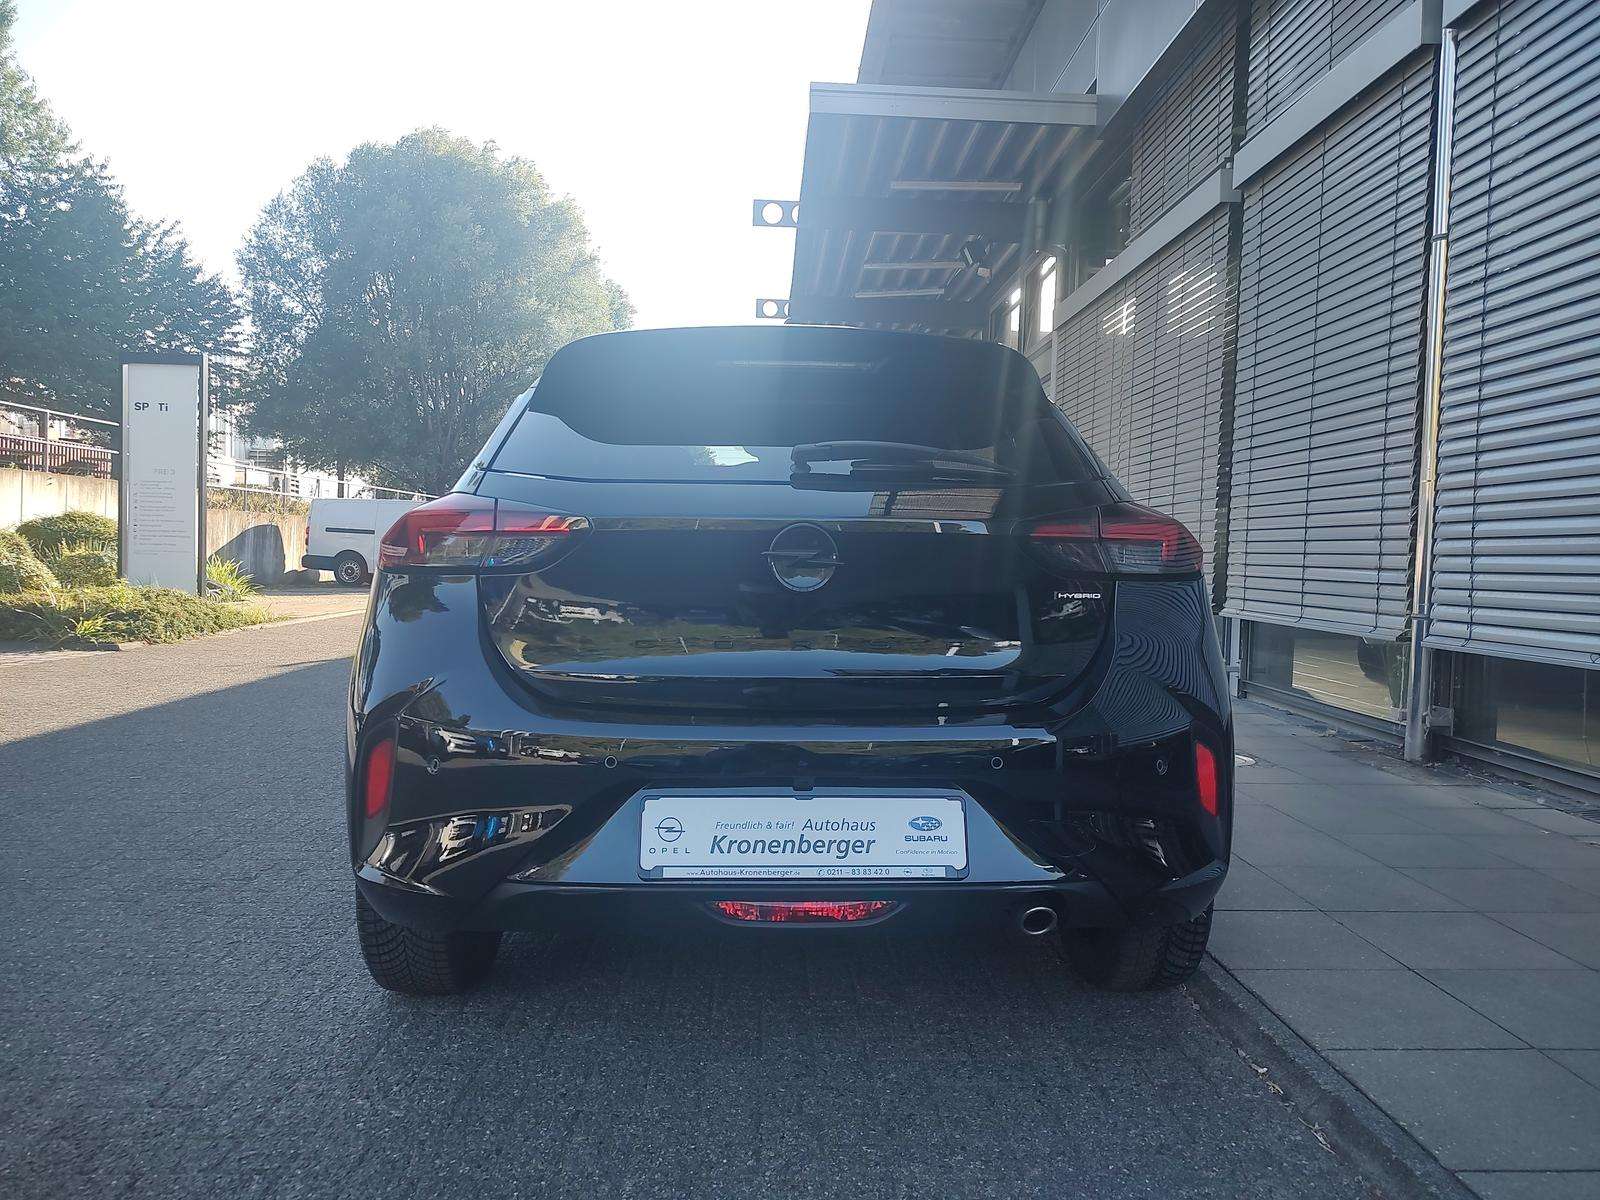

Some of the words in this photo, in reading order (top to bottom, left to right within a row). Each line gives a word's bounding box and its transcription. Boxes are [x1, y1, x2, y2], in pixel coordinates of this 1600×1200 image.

[134, 402, 150, 411] SP
[158, 402, 168, 412] Ti
[714, 820, 763, 830] Freundlich
[765, 821, 773, 830] &
[775, 820, 795, 830] fair!
[801, 817, 876, 832] Autohaus
[709, 833, 877, 860] Kronenberger
[826, 868, 843, 876] 0211
